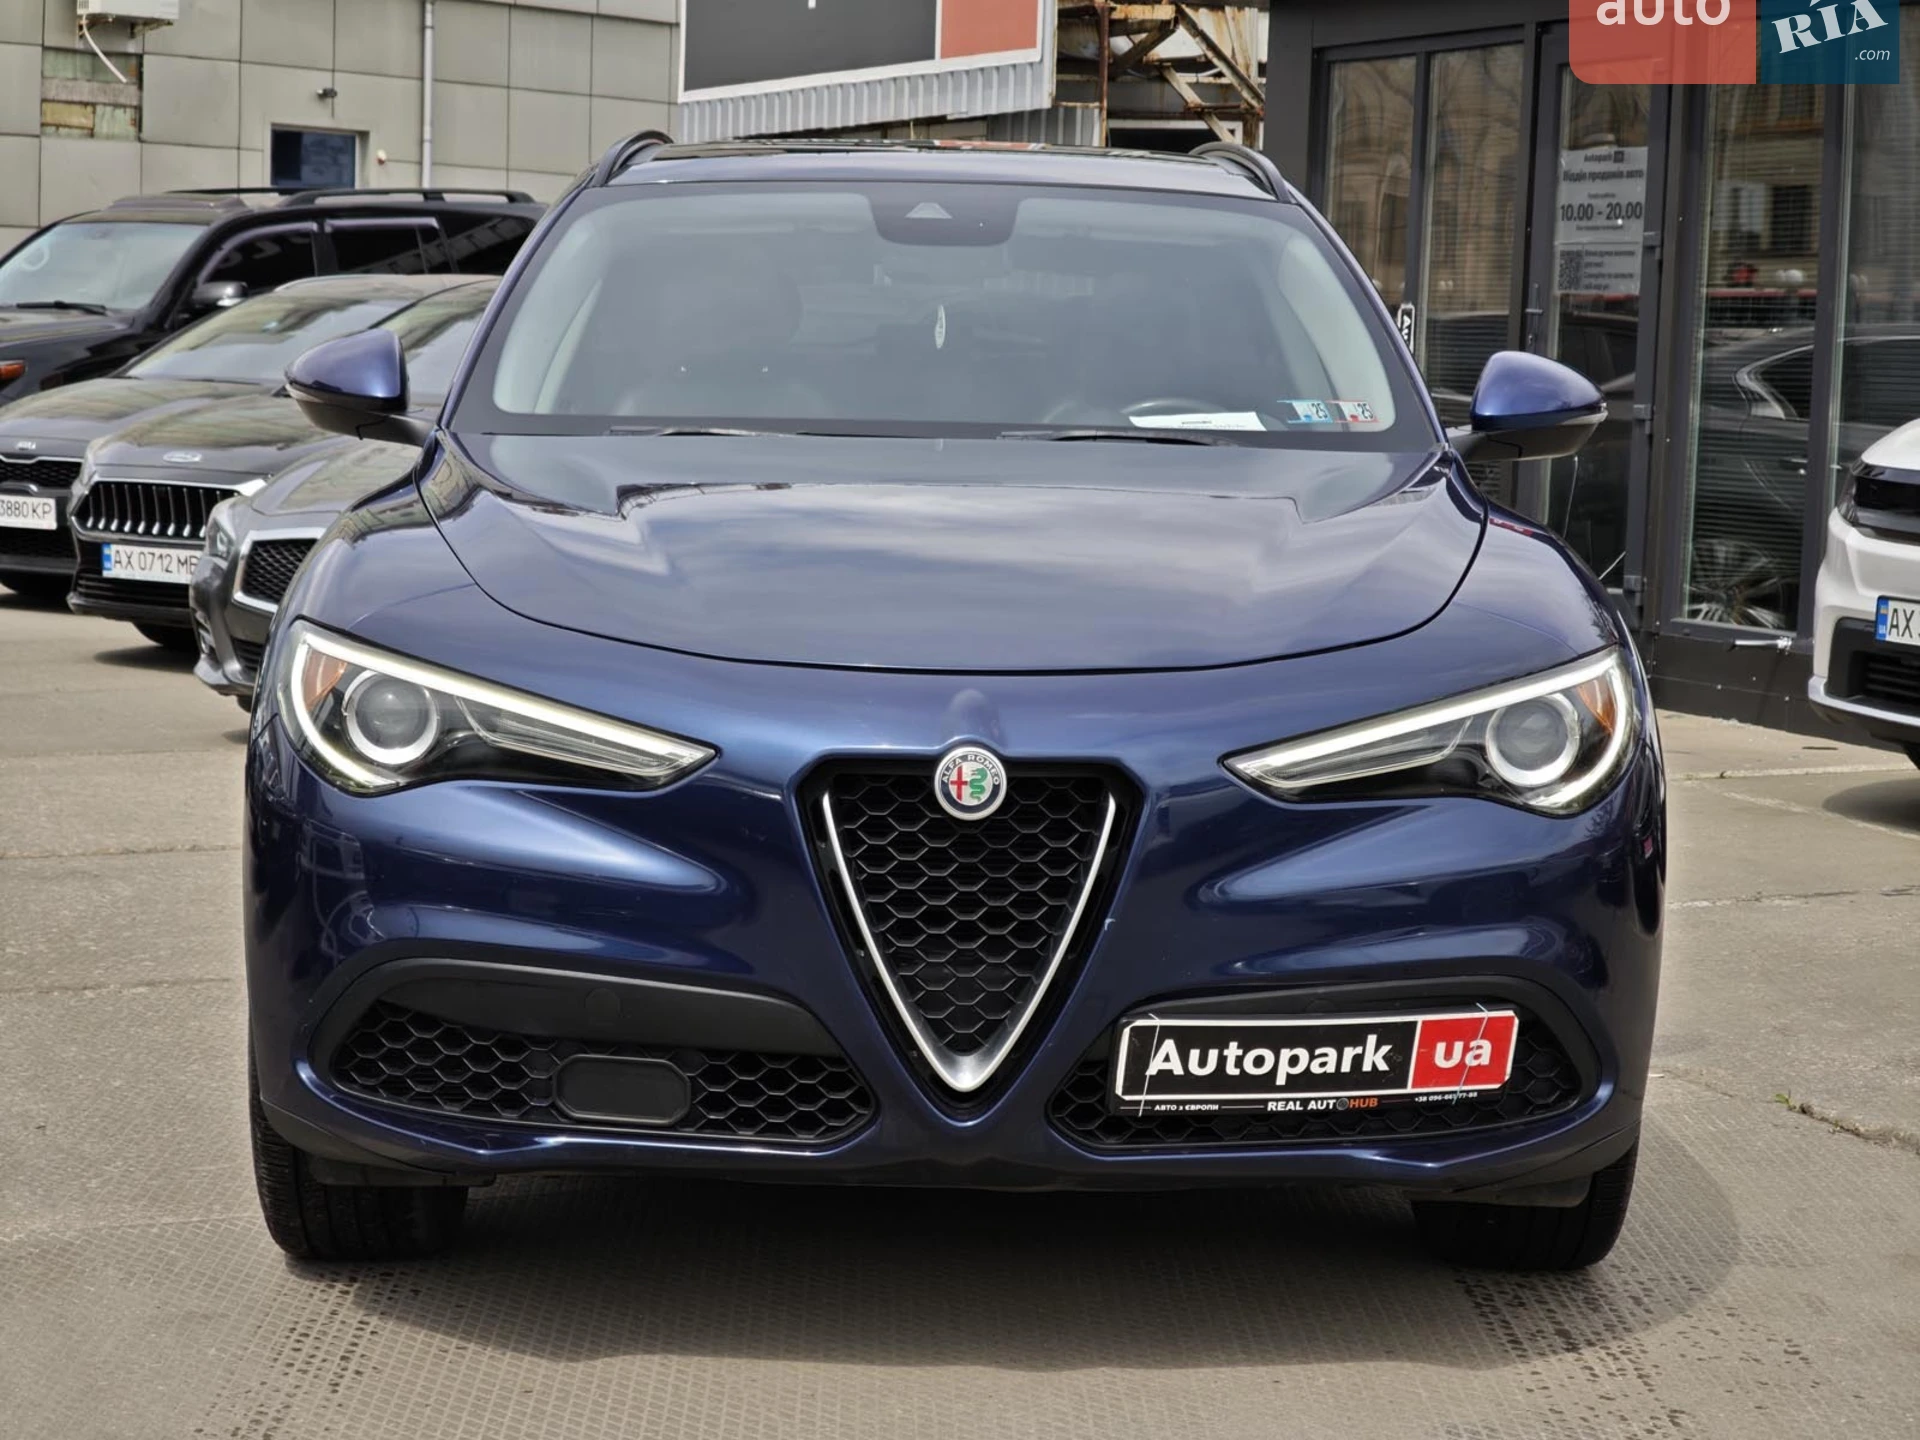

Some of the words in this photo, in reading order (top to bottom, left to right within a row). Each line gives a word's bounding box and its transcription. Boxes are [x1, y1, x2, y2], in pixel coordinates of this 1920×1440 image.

[1561, 203, 1594, 221] 10.00
[1606, 201, 1643, 220] 20.00
[138, 552, 174, 573] 0712
[1888, 608, 1915, 638] AX
[942, 758, 962, 783] ALFA
[967, 754, 1000, 785] ROMEO
[1146, 1034, 1392, 1085] Autopark
[1434, 1039, 1492, 1069] ua
[1267, 1101, 1303, 1111] REAL
